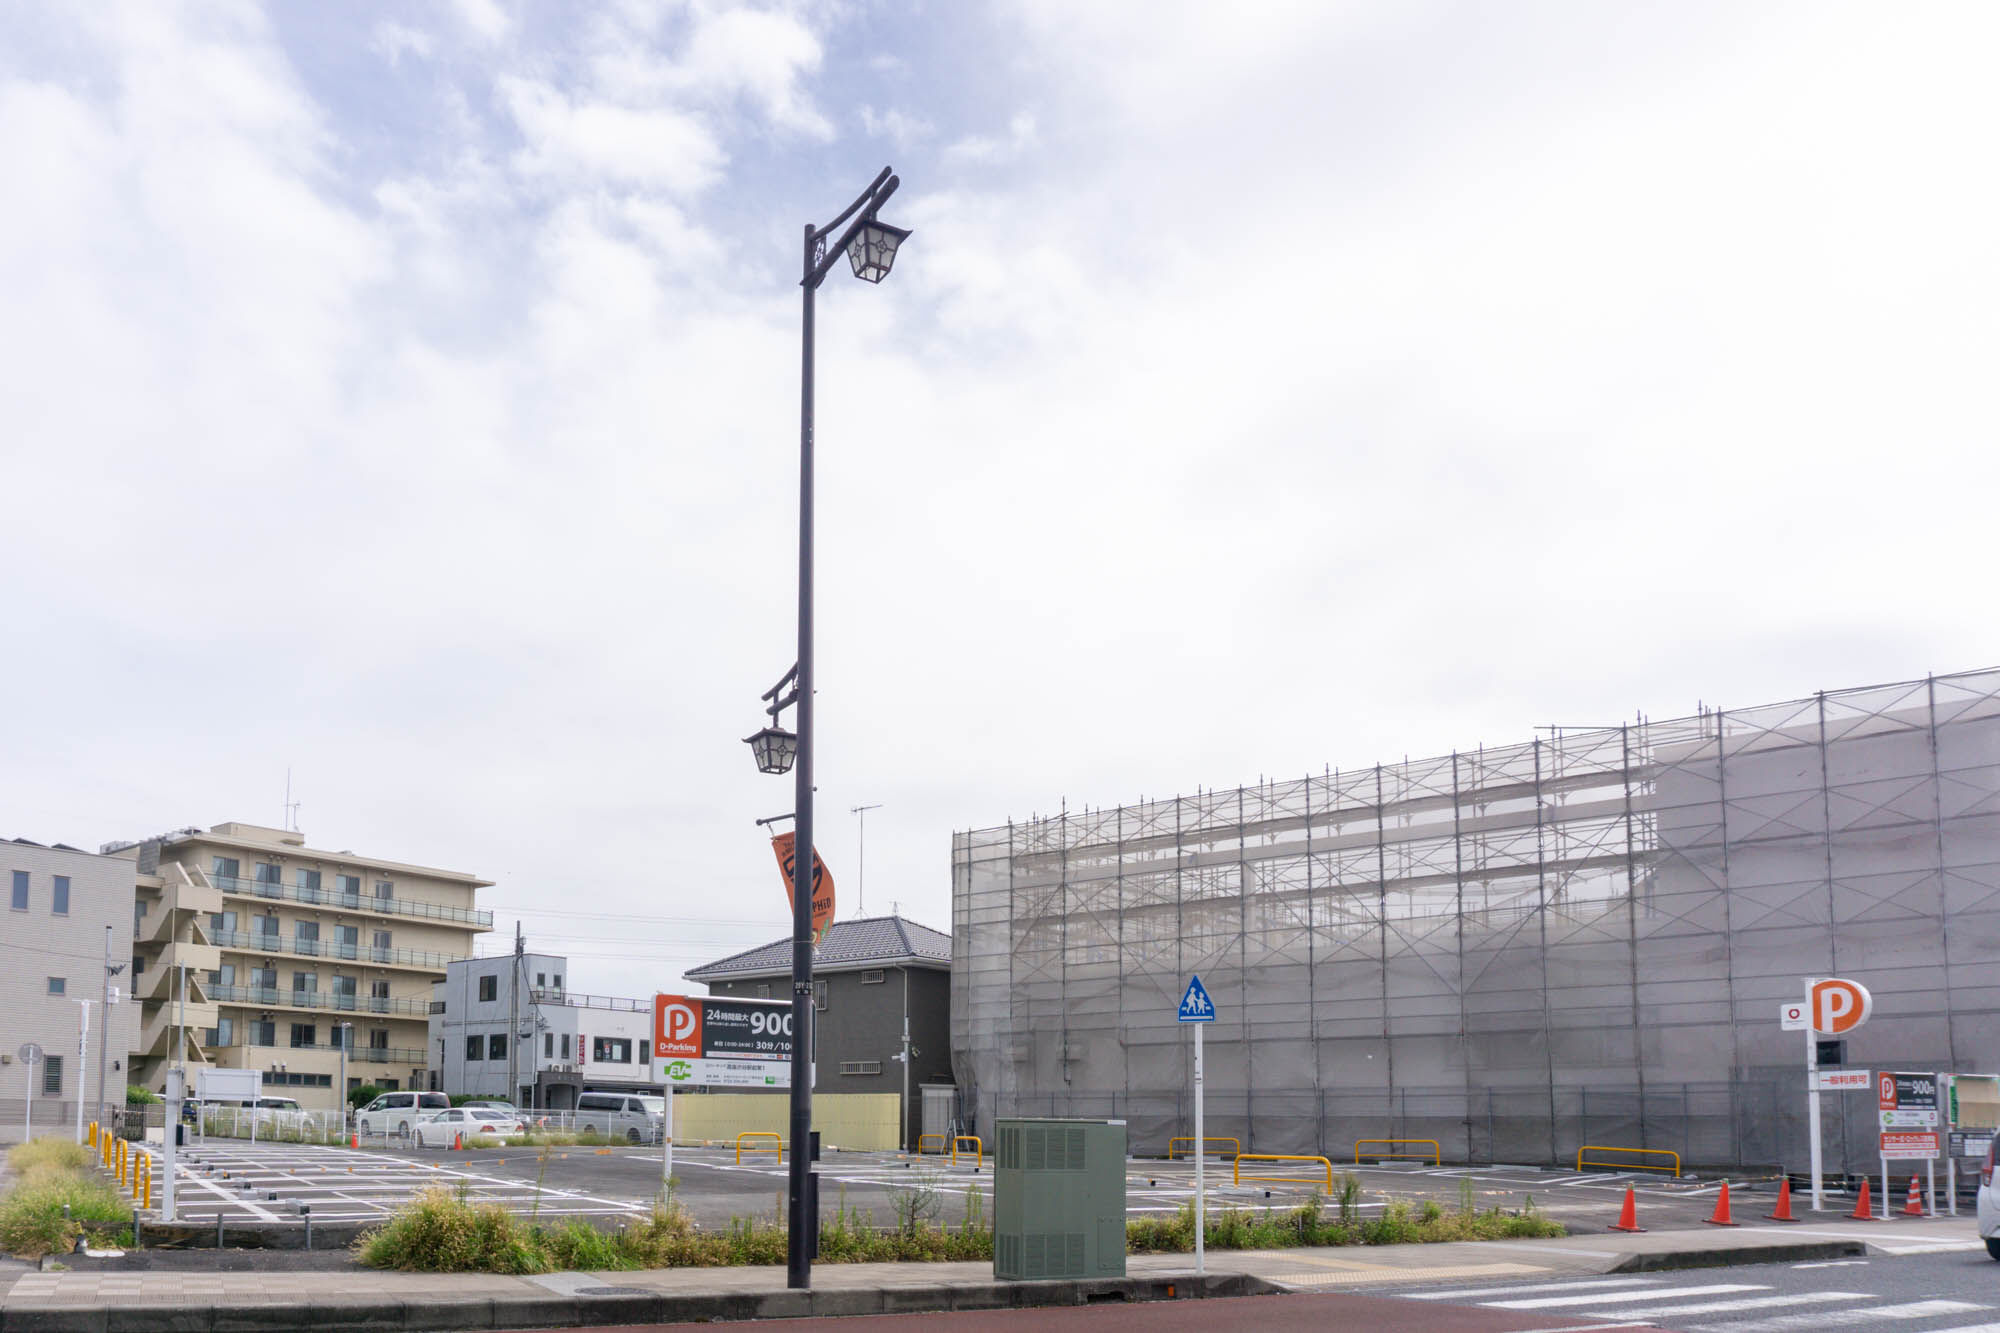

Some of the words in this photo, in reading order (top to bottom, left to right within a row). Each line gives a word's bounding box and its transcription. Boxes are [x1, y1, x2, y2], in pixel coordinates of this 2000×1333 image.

[706, 1009, 749, 1022] 24時間最大
[1821, 987, 1854, 1032] P
[659, 1042, 697, 1053] D-Parking
[756, 1041, 792, 1051] 30分/10
[670, 1064, 687, 1076] EV
